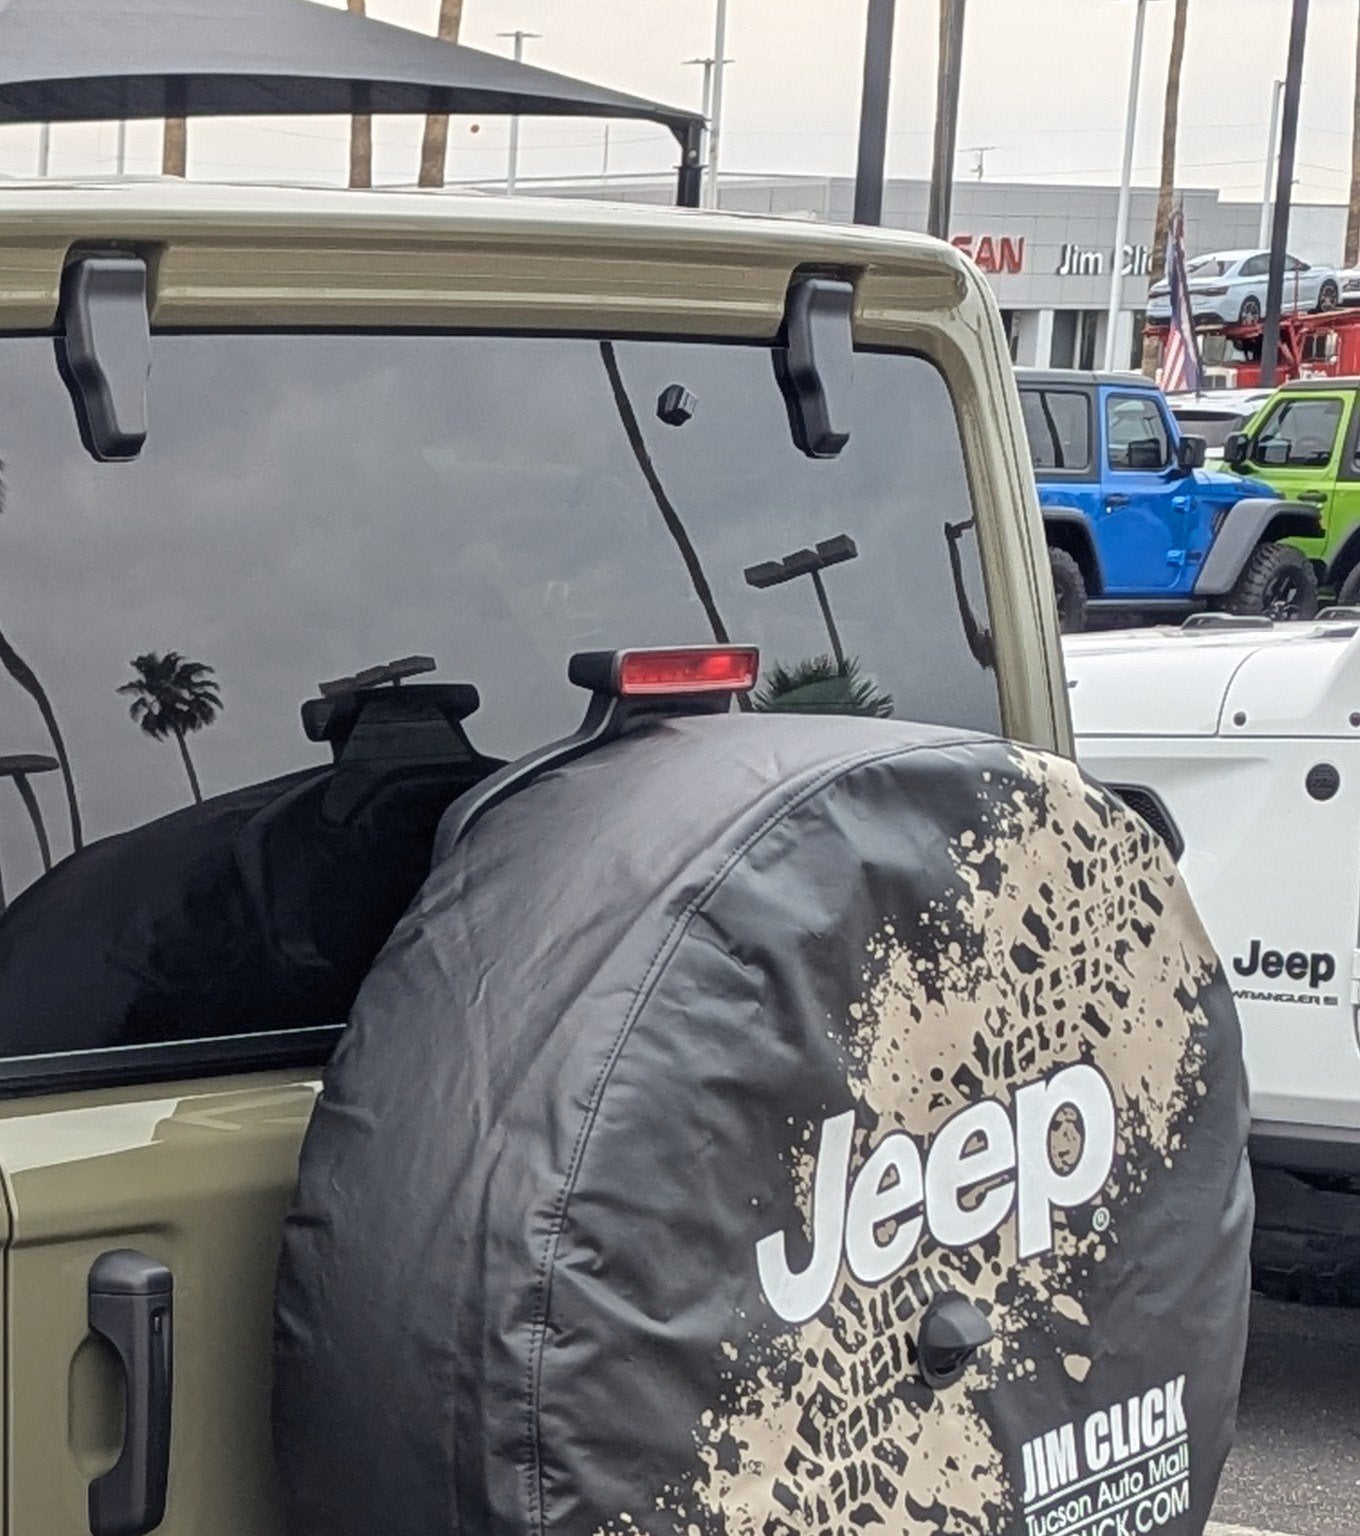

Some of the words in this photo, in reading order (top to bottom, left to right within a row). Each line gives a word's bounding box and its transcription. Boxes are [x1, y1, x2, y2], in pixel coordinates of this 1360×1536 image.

[1058, 244, 1102, 276] Jim
[1233, 940, 1335, 988] Jeep
[754, 1064, 1116, 1323] Jeep
[1021, 1422, 1079, 1504] JIM
[1084, 1374, 1188, 1472] CLICK
[1097, 1470, 1144, 1511] Auto
[1148, 1442, 1189, 1486] Mall
